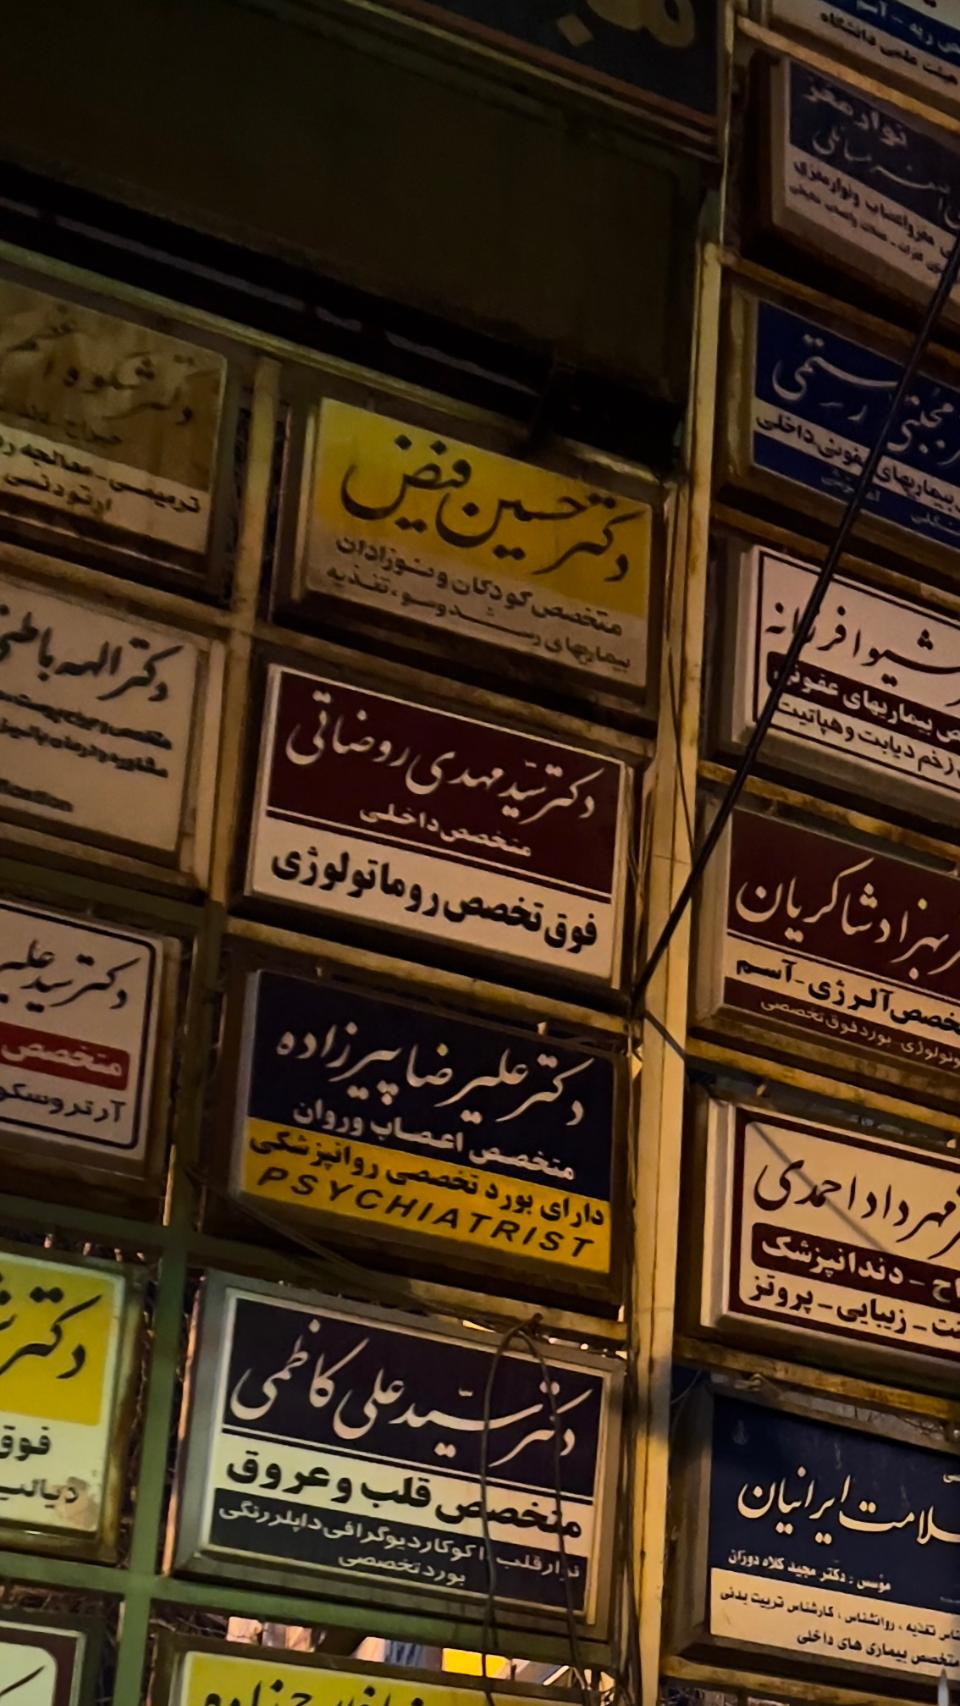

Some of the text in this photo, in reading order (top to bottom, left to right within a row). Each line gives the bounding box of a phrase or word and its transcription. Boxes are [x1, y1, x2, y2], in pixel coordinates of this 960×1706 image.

[820, 13, 876, 45] دانشگاه
[756, 414, 813, 444] داخلی
[886, 395, 953, 453] مجتبی
[340, 435, 643, 581] دکتر حسین فیض
[878, 460, 953, 511] بیماریهای
[335, 537, 621, 636] متخصص کودکان و نوزادان
[53, 637, 183, 701] دکتر الهه
[775, 694, 842, 734] هپاتیت
[843, 690, 932, 734] بیماریهای
[844, 729, 854, 741] و
[286, 691, 603, 823] دکتر مهدی روضاتی
[857, 731, 914, 758] دیابت
[917, 751, 954, 775] زخم
[359, 804, 530, 856] متخصص داخلی
[271, 847, 596, 953] فوق تخصص روماتولوژی
[736, 858, 876, 941] شاکریان
[875, 898, 948, 979] بهزاد
[19, 954, 139, 1012] دکتر سید
[736, 958, 796, 982] آسم
[808, 980, 893, 1011] آلرژی
[760, 1002, 891, 1045] بورد فوق تخصصی
[1, 1043, 121, 1076] متخصص
[277, 1022, 593, 1125] دکتر علیرضا پیرزاده
[370, 1117, 573, 1179] متخصص اعصاب
[249, 1131, 603, 1227] دارای بورد تخصصی روانپزشکی
[753, 1153, 856, 1221] احمدی
[257, 1166, 592, 1255] PSYCHIATRIST
[861, 1185, 956, 1253] مهرداد
[762, 1236, 902, 1283] دندانپزشک
[749, 1274, 813, 1313] پروتز
[836, 1298, 906, 1334] زیبایی
[0, 1286, 101, 1378] دکتر
[230, 1320, 590, 1466] دکتر علی کاظمی
[227, 1450, 581, 1547] متخصص قلب و عروق
[738, 1467, 849, 1543] ایرانیان
[219, 1500, 541, 1570] قلب اکوکاردیوگرافی داپلر رنگی
[338, 1556, 465, 1585] بورد تخصصی
[762, 1556, 845, 1582] دکتر مجید کلاه
[720, 1591, 747, 1604] بدنی
[750, 1593, 784, 1608] تربیت
[787, 1602, 833, 1617] کارشناس
[844, 1612, 894, 1630] روانشناس
[796, 1630, 960, 1667] متخصص بیماری های داخلی
